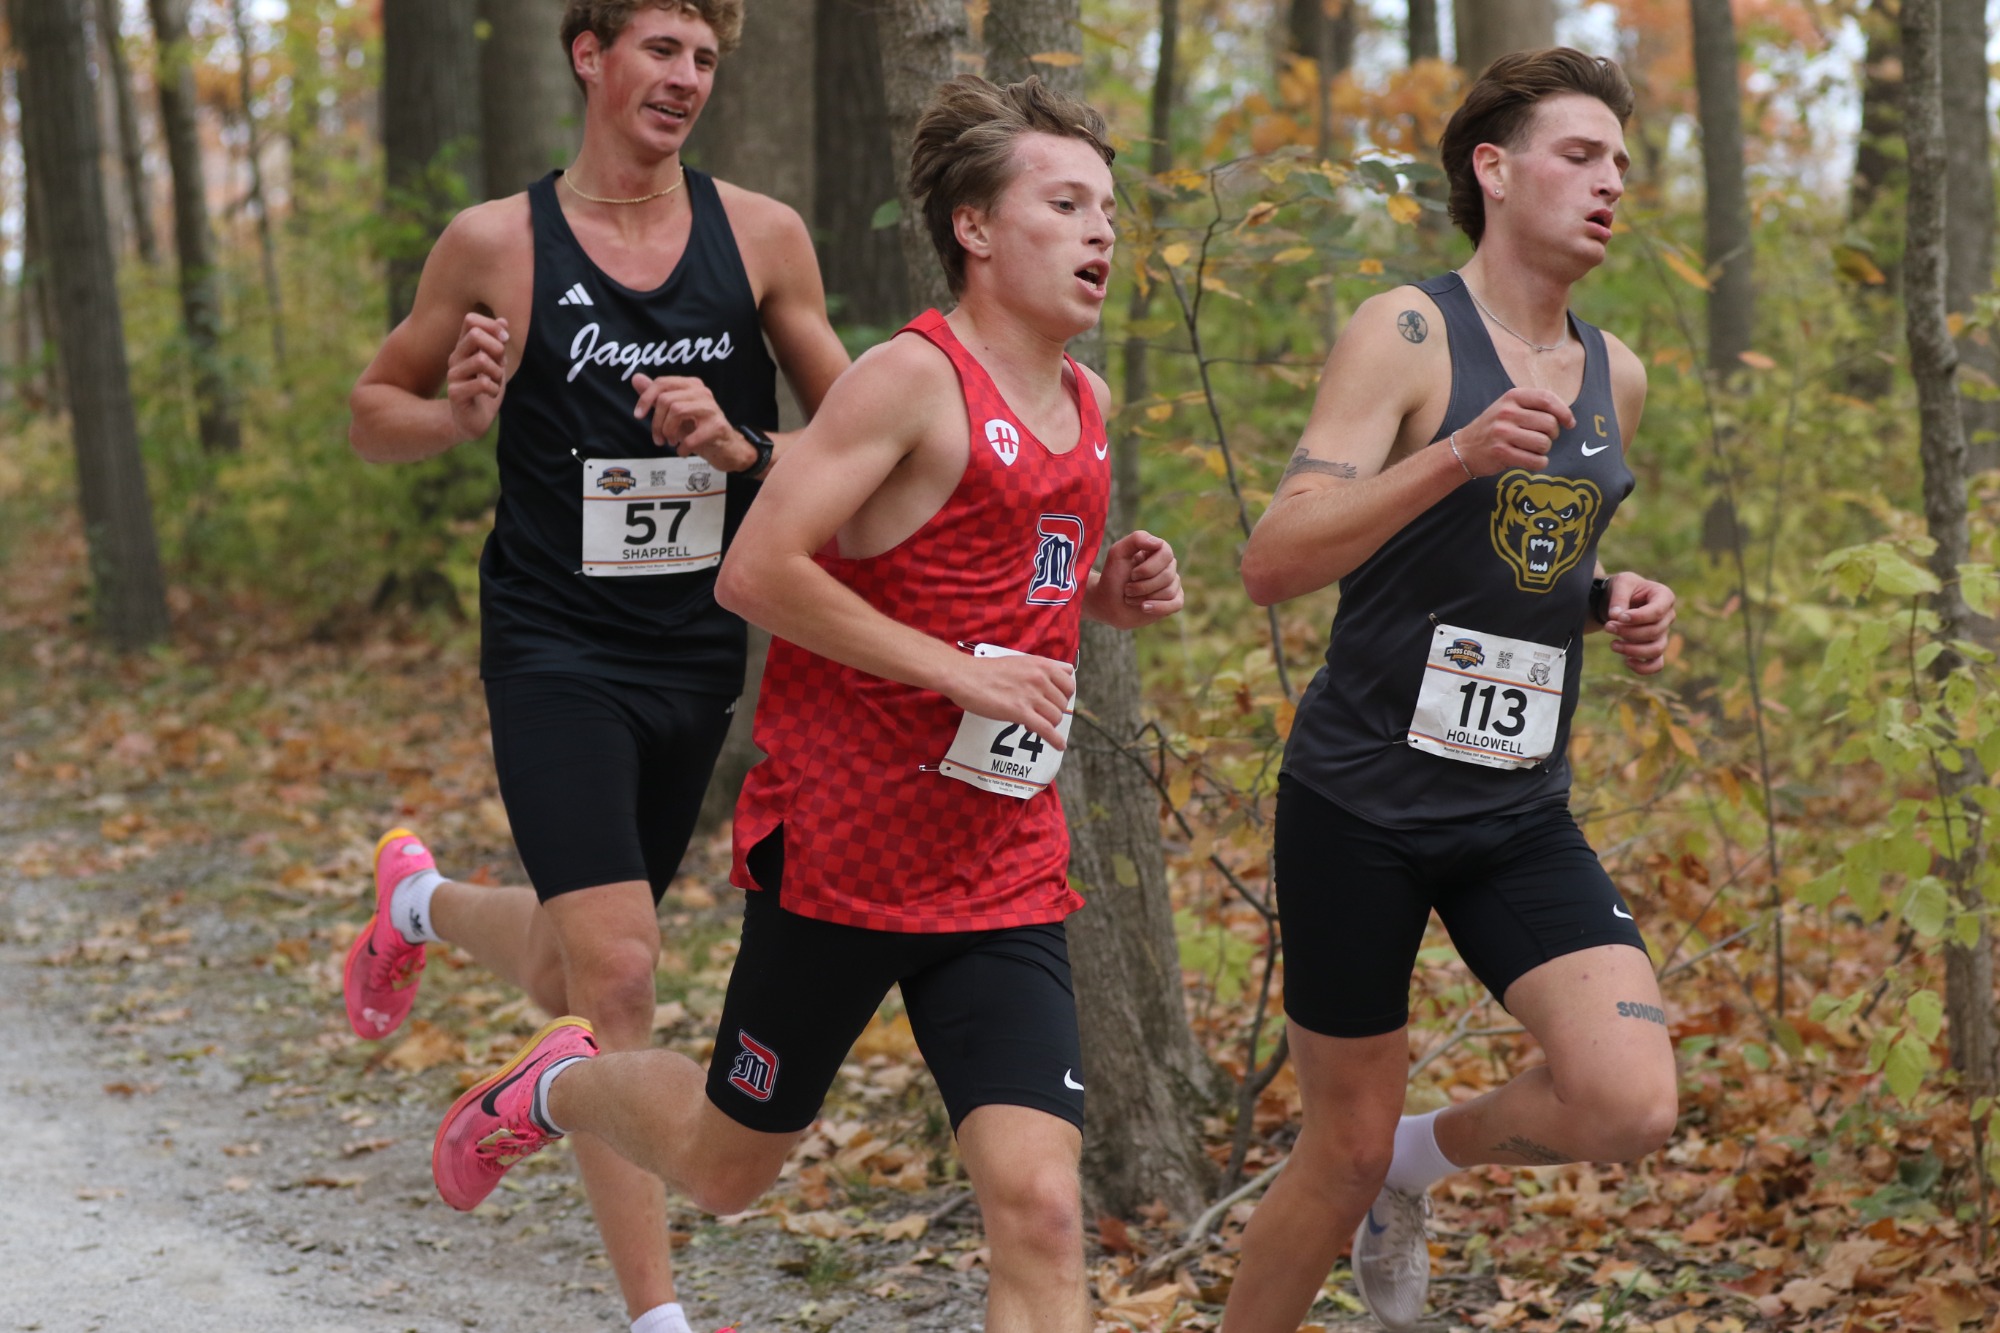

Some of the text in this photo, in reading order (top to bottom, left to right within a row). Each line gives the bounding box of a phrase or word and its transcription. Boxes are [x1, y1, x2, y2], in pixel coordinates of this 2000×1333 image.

[566, 322, 735, 383] Jaguars
[1593, 414, 1608, 438] C
[624, 501, 691, 545] 57
[622, 547, 691, 560] SHAPPELL
[1446, 647, 1463, 655] CROSS
[1463, 649, 1484, 662] COUNTRY
[1460, 681, 1528, 737] 113
[990, 724, 1044, 763] 24
[1446, 729, 1524, 755] HOLLOWELL
[991, 758, 1032, 779] MURRAY
